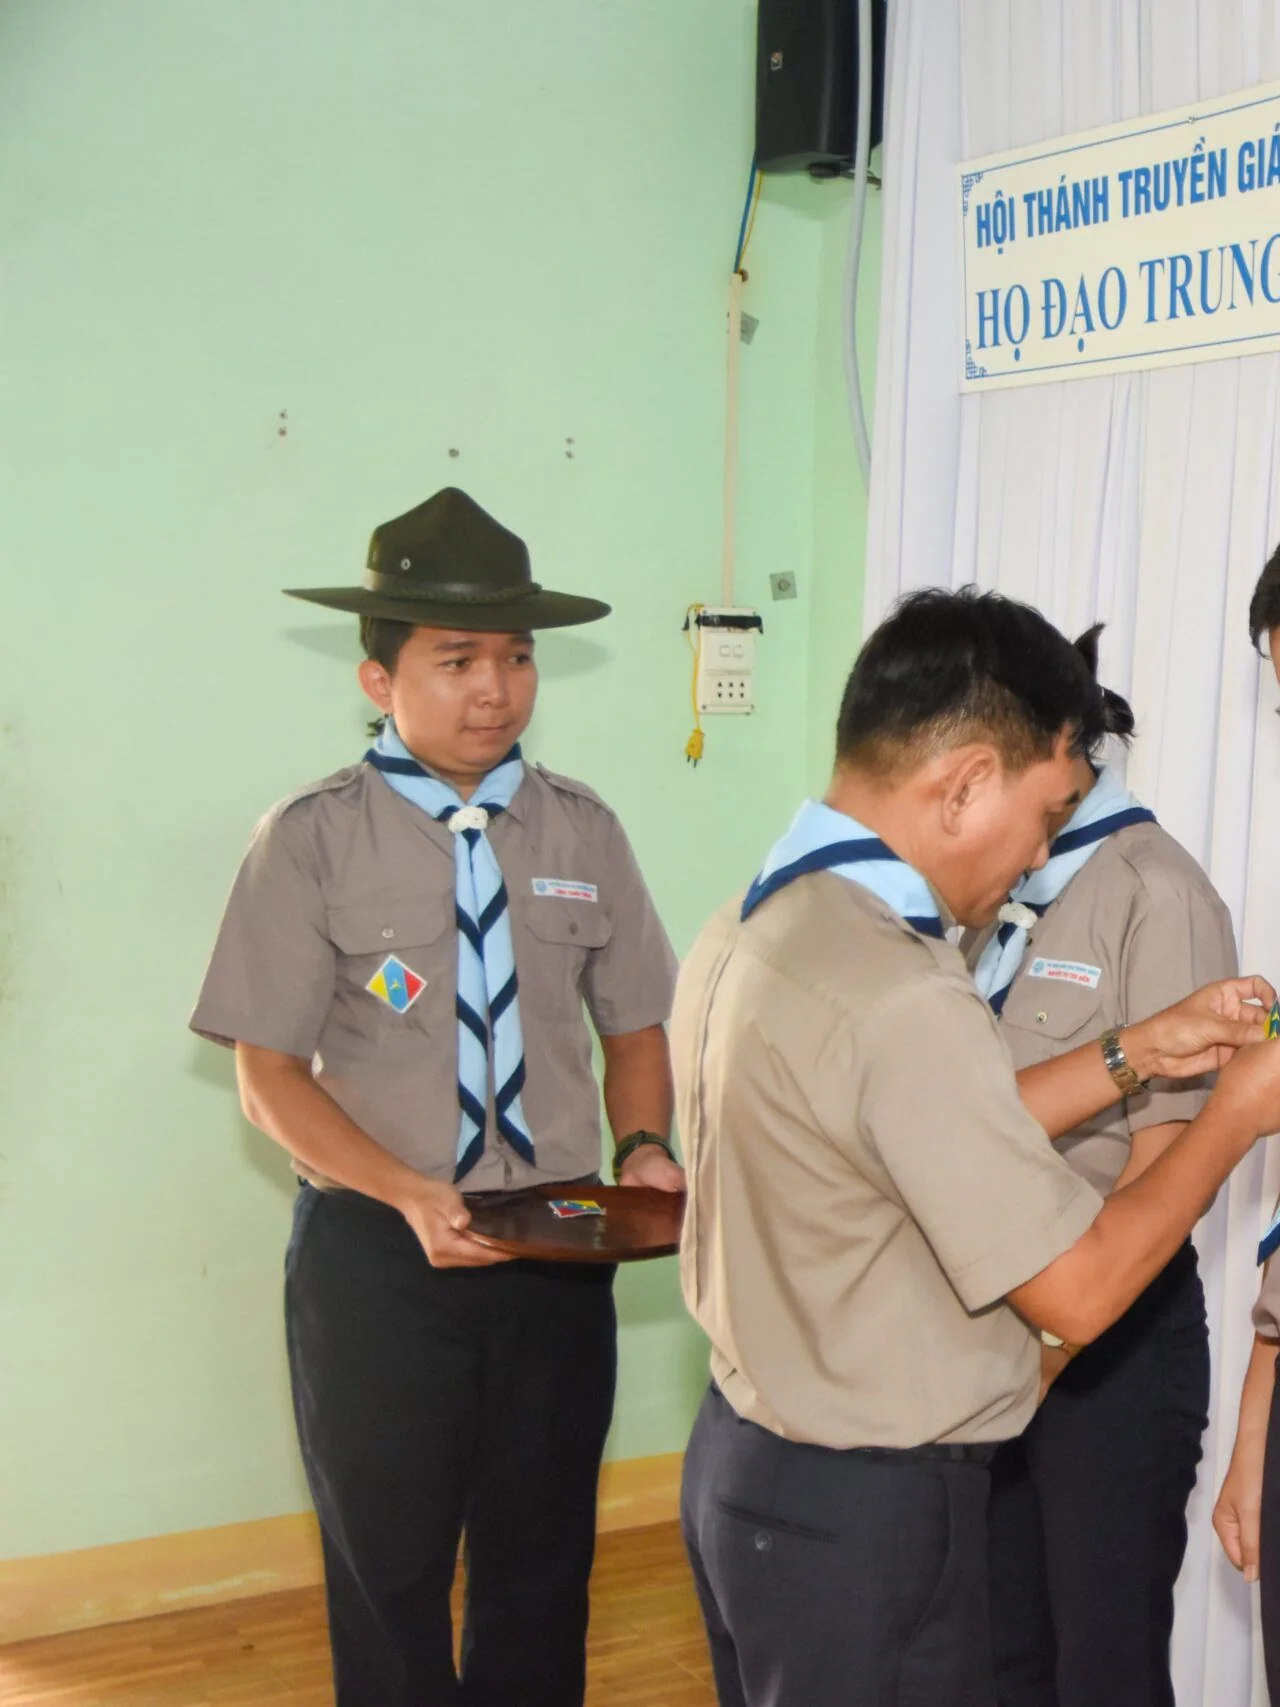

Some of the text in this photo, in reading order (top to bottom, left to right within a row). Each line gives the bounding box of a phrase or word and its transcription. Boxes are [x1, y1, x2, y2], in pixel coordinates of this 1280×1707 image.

[975, 189, 1016, 255] HỘI
[1023, 174, 1110, 238] THÁNH
[1118, 136, 1228, 218] TRUYỀN
[975, 283, 1031, 362] HỌ
[1040, 266, 1128, 353] ĐẠO
